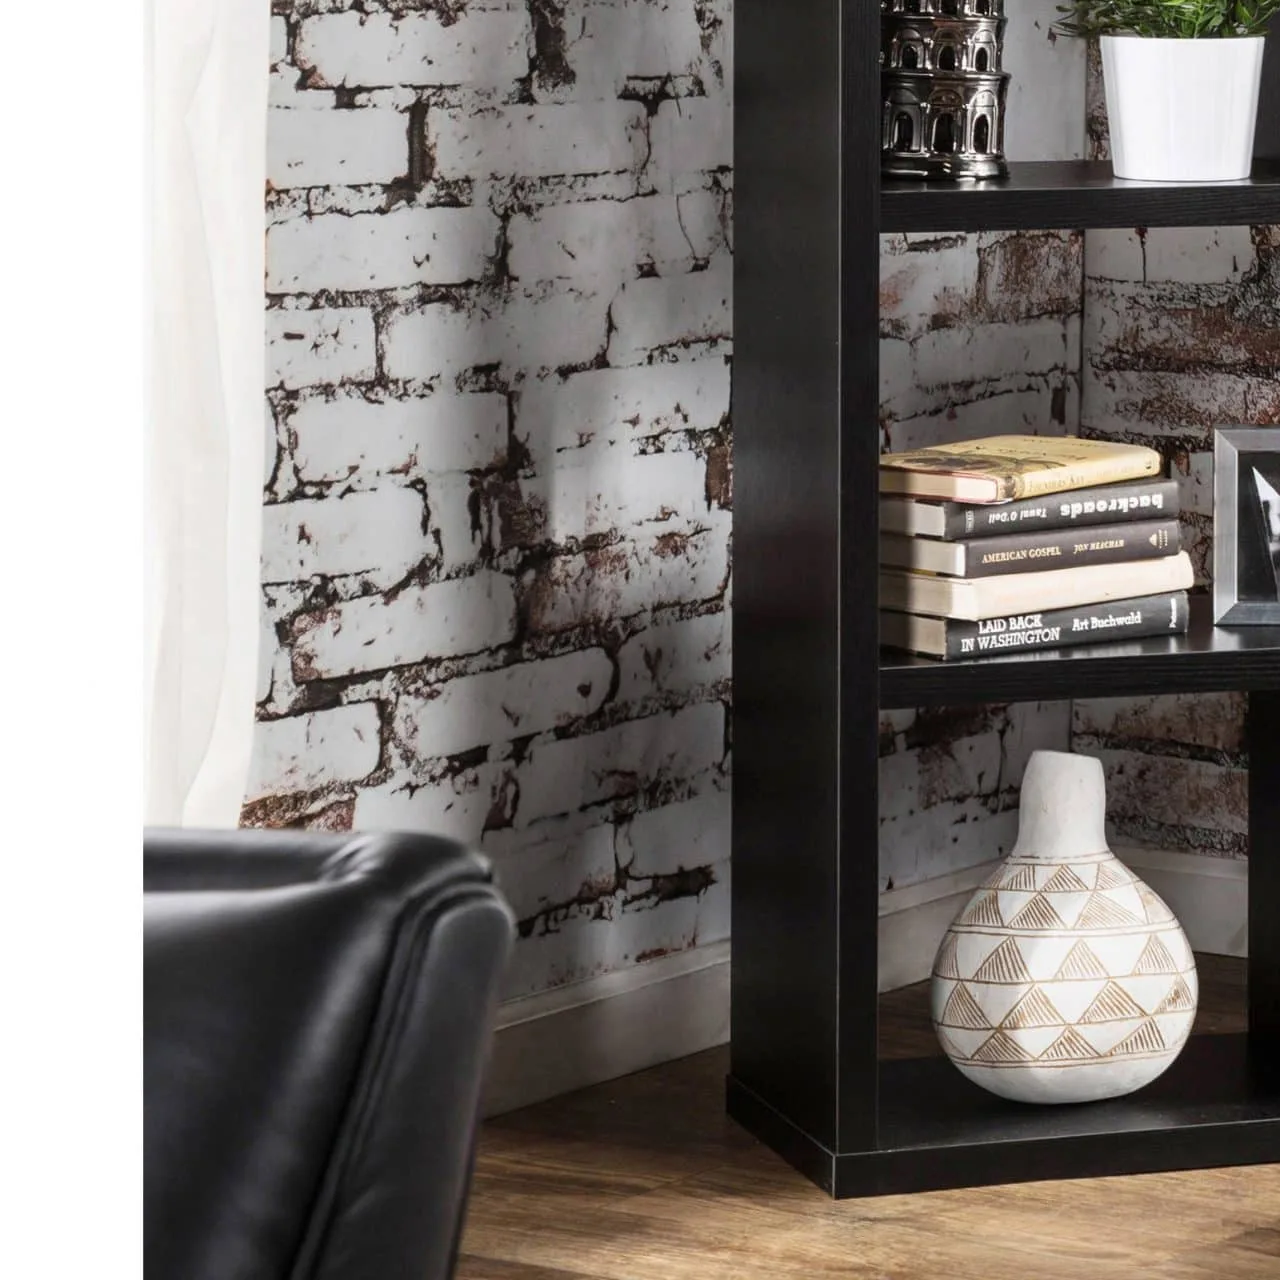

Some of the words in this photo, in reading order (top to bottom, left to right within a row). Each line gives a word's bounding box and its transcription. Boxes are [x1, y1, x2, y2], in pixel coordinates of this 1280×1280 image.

[1060, 493, 1164, 518] backroads
[982, 549, 1028, 564] AMERICAN
[1029, 546, 1061, 559] GOSPEL
[1073, 543, 1089, 554] JON
[1089, 539, 1125, 551] MEACHAM
[978, 617, 1007, 634] LAID
[1009, 614, 1042, 631] BACK
[1072, 618, 1089, 631] Art
[1090, 611, 1142, 629] Buchwald
[961, 638, 975, 652] IN
[976, 627, 1061, 650] WASHINGTON
